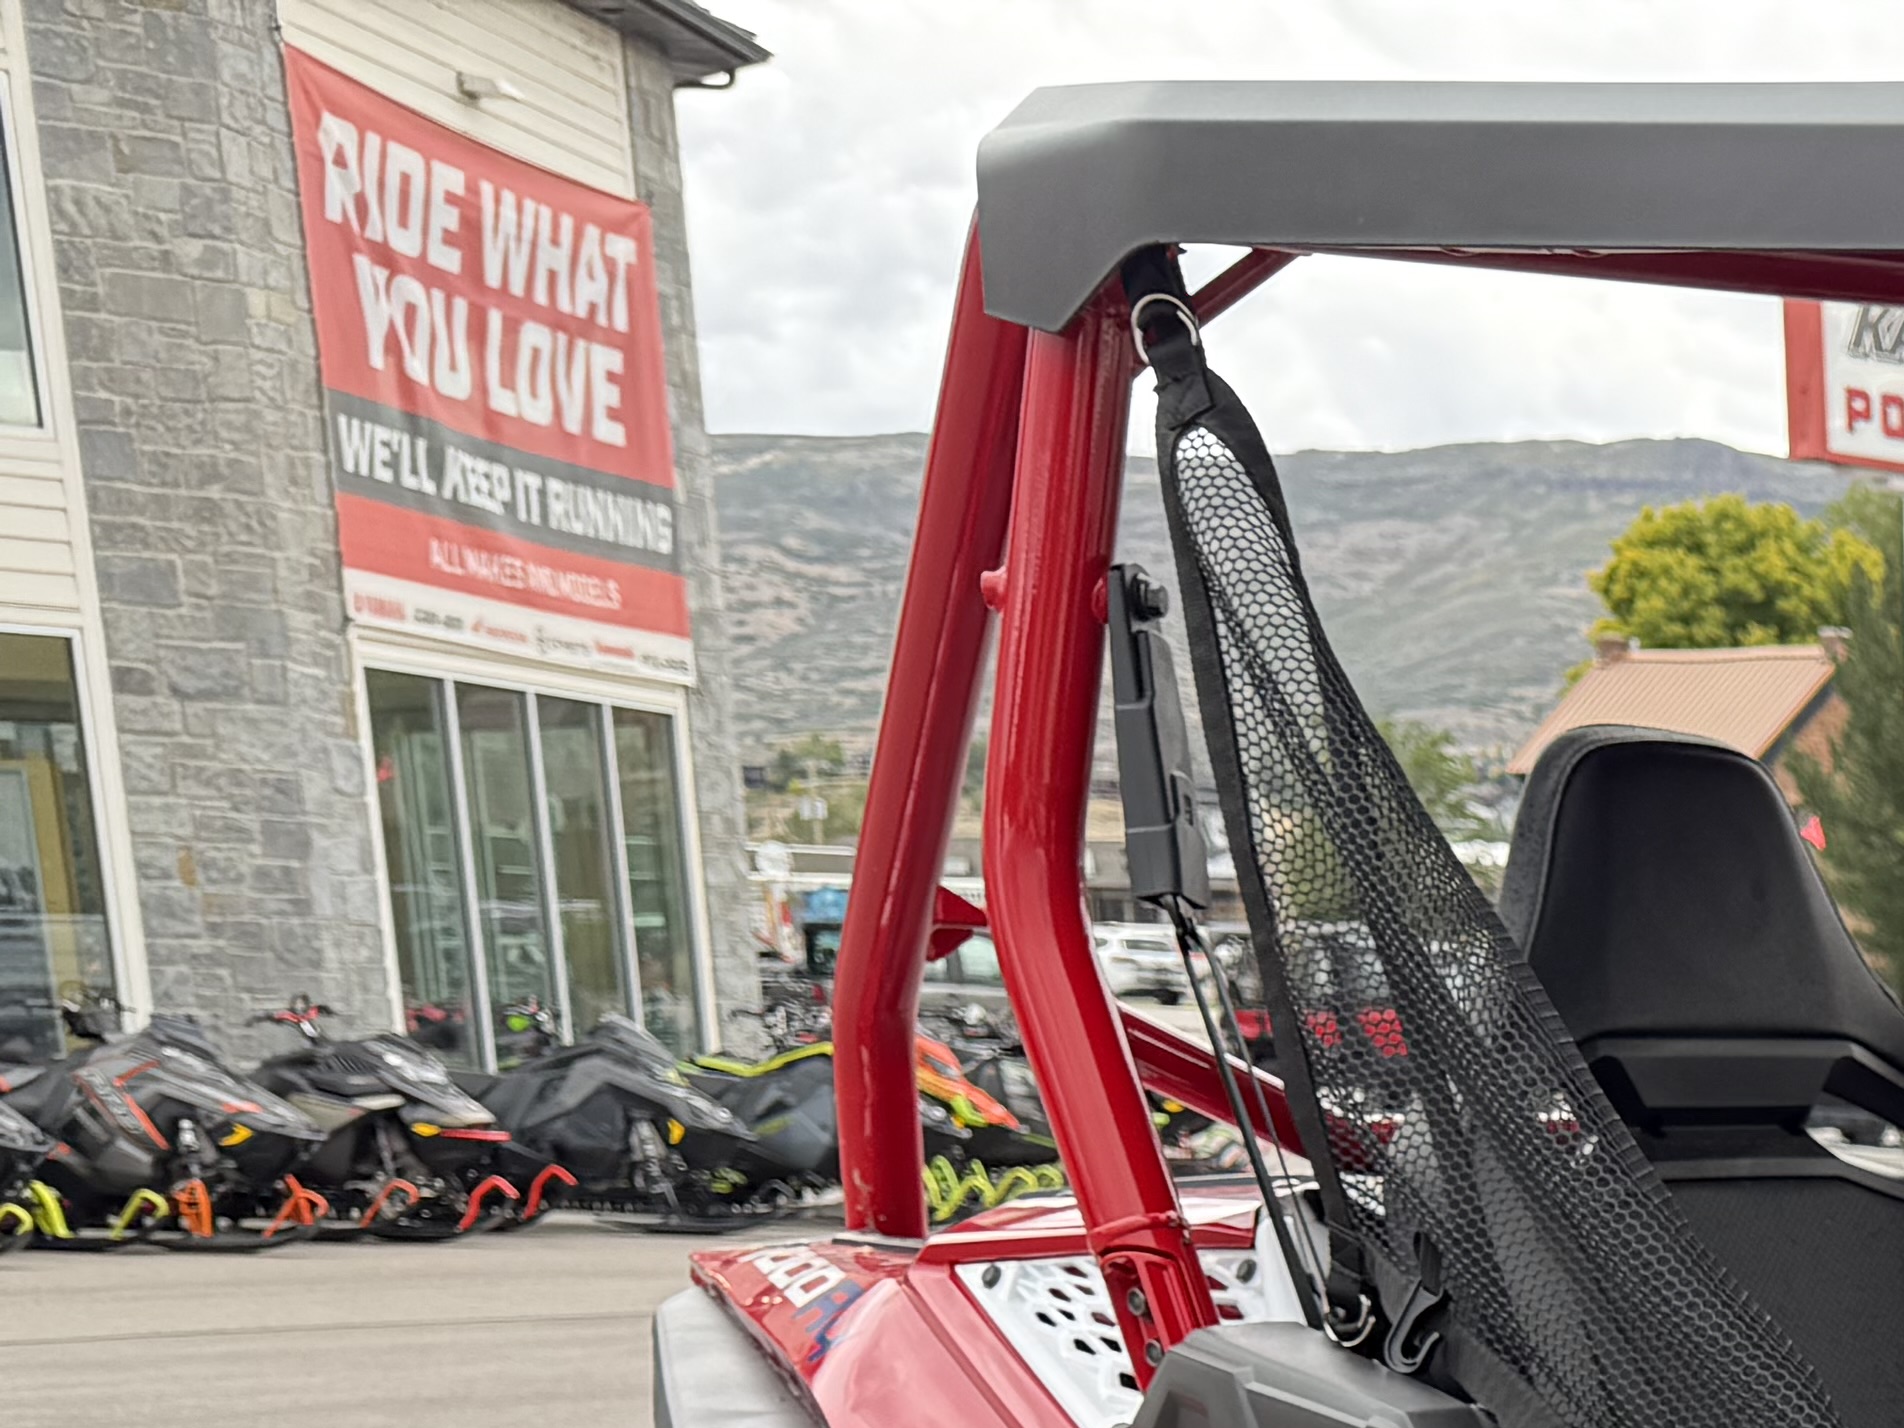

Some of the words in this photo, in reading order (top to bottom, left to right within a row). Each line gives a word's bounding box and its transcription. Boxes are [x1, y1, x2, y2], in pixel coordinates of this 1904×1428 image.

[318, 110, 465, 275] RIDE
[479, 179, 638, 333] WHAT
[352, 252, 472, 401] YOU
[486, 307, 628, 448] LOVE
[337, 413, 437, 496] WE'LL
[441, 445, 511, 515] KEEP
[513, 468, 543, 526] IT
[545, 476, 673, 555] RUNNING
